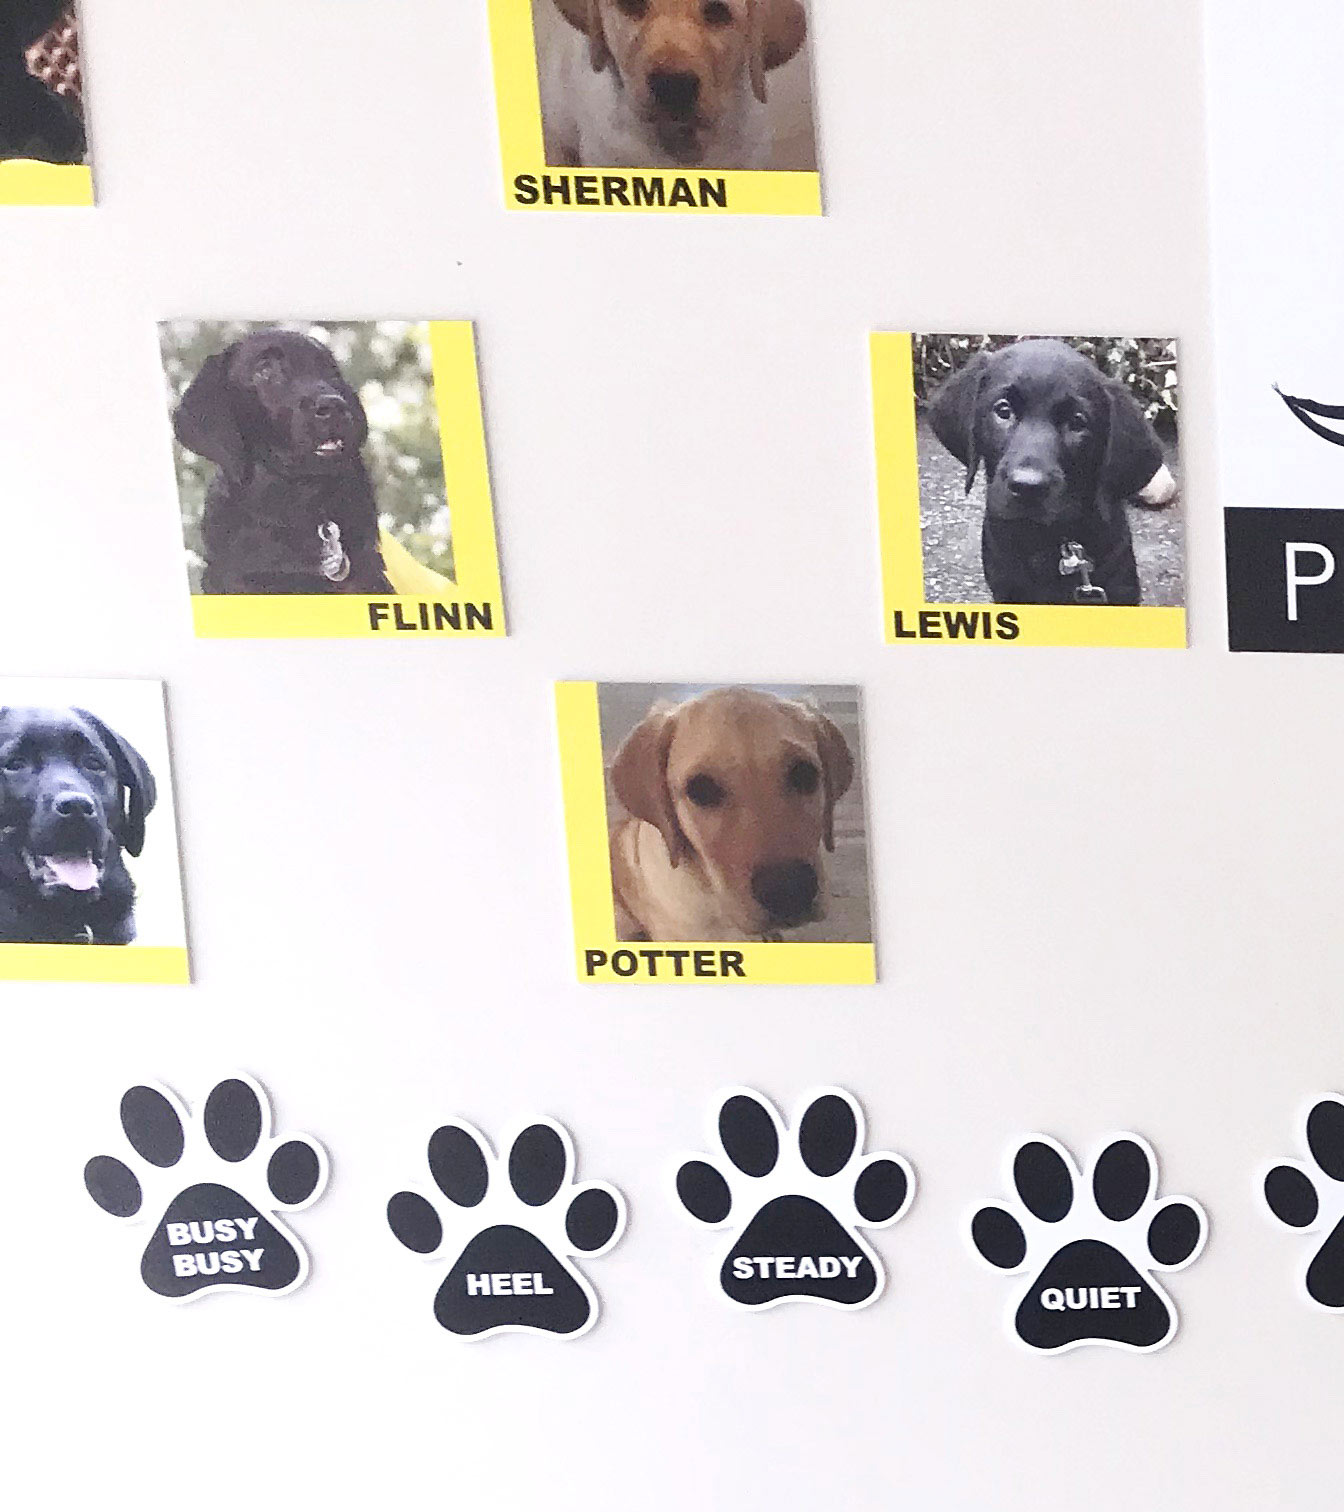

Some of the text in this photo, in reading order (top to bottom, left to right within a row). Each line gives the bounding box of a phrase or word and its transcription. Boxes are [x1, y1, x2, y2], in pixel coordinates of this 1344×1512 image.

[513, 174, 728, 208] SHERMAN
[367, 602, 494, 631] FLINN
[893, 610, 1020, 641] LEWIS
[584, 949, 746, 978] POTTER
[166, 1216, 259, 1246] BUSY
[172, 1248, 265, 1277] BUSY
[732, 1256, 863, 1279] STEADY
[466, 1272, 554, 1296] HEEL
[1040, 1286, 1142, 1312] QUIET
